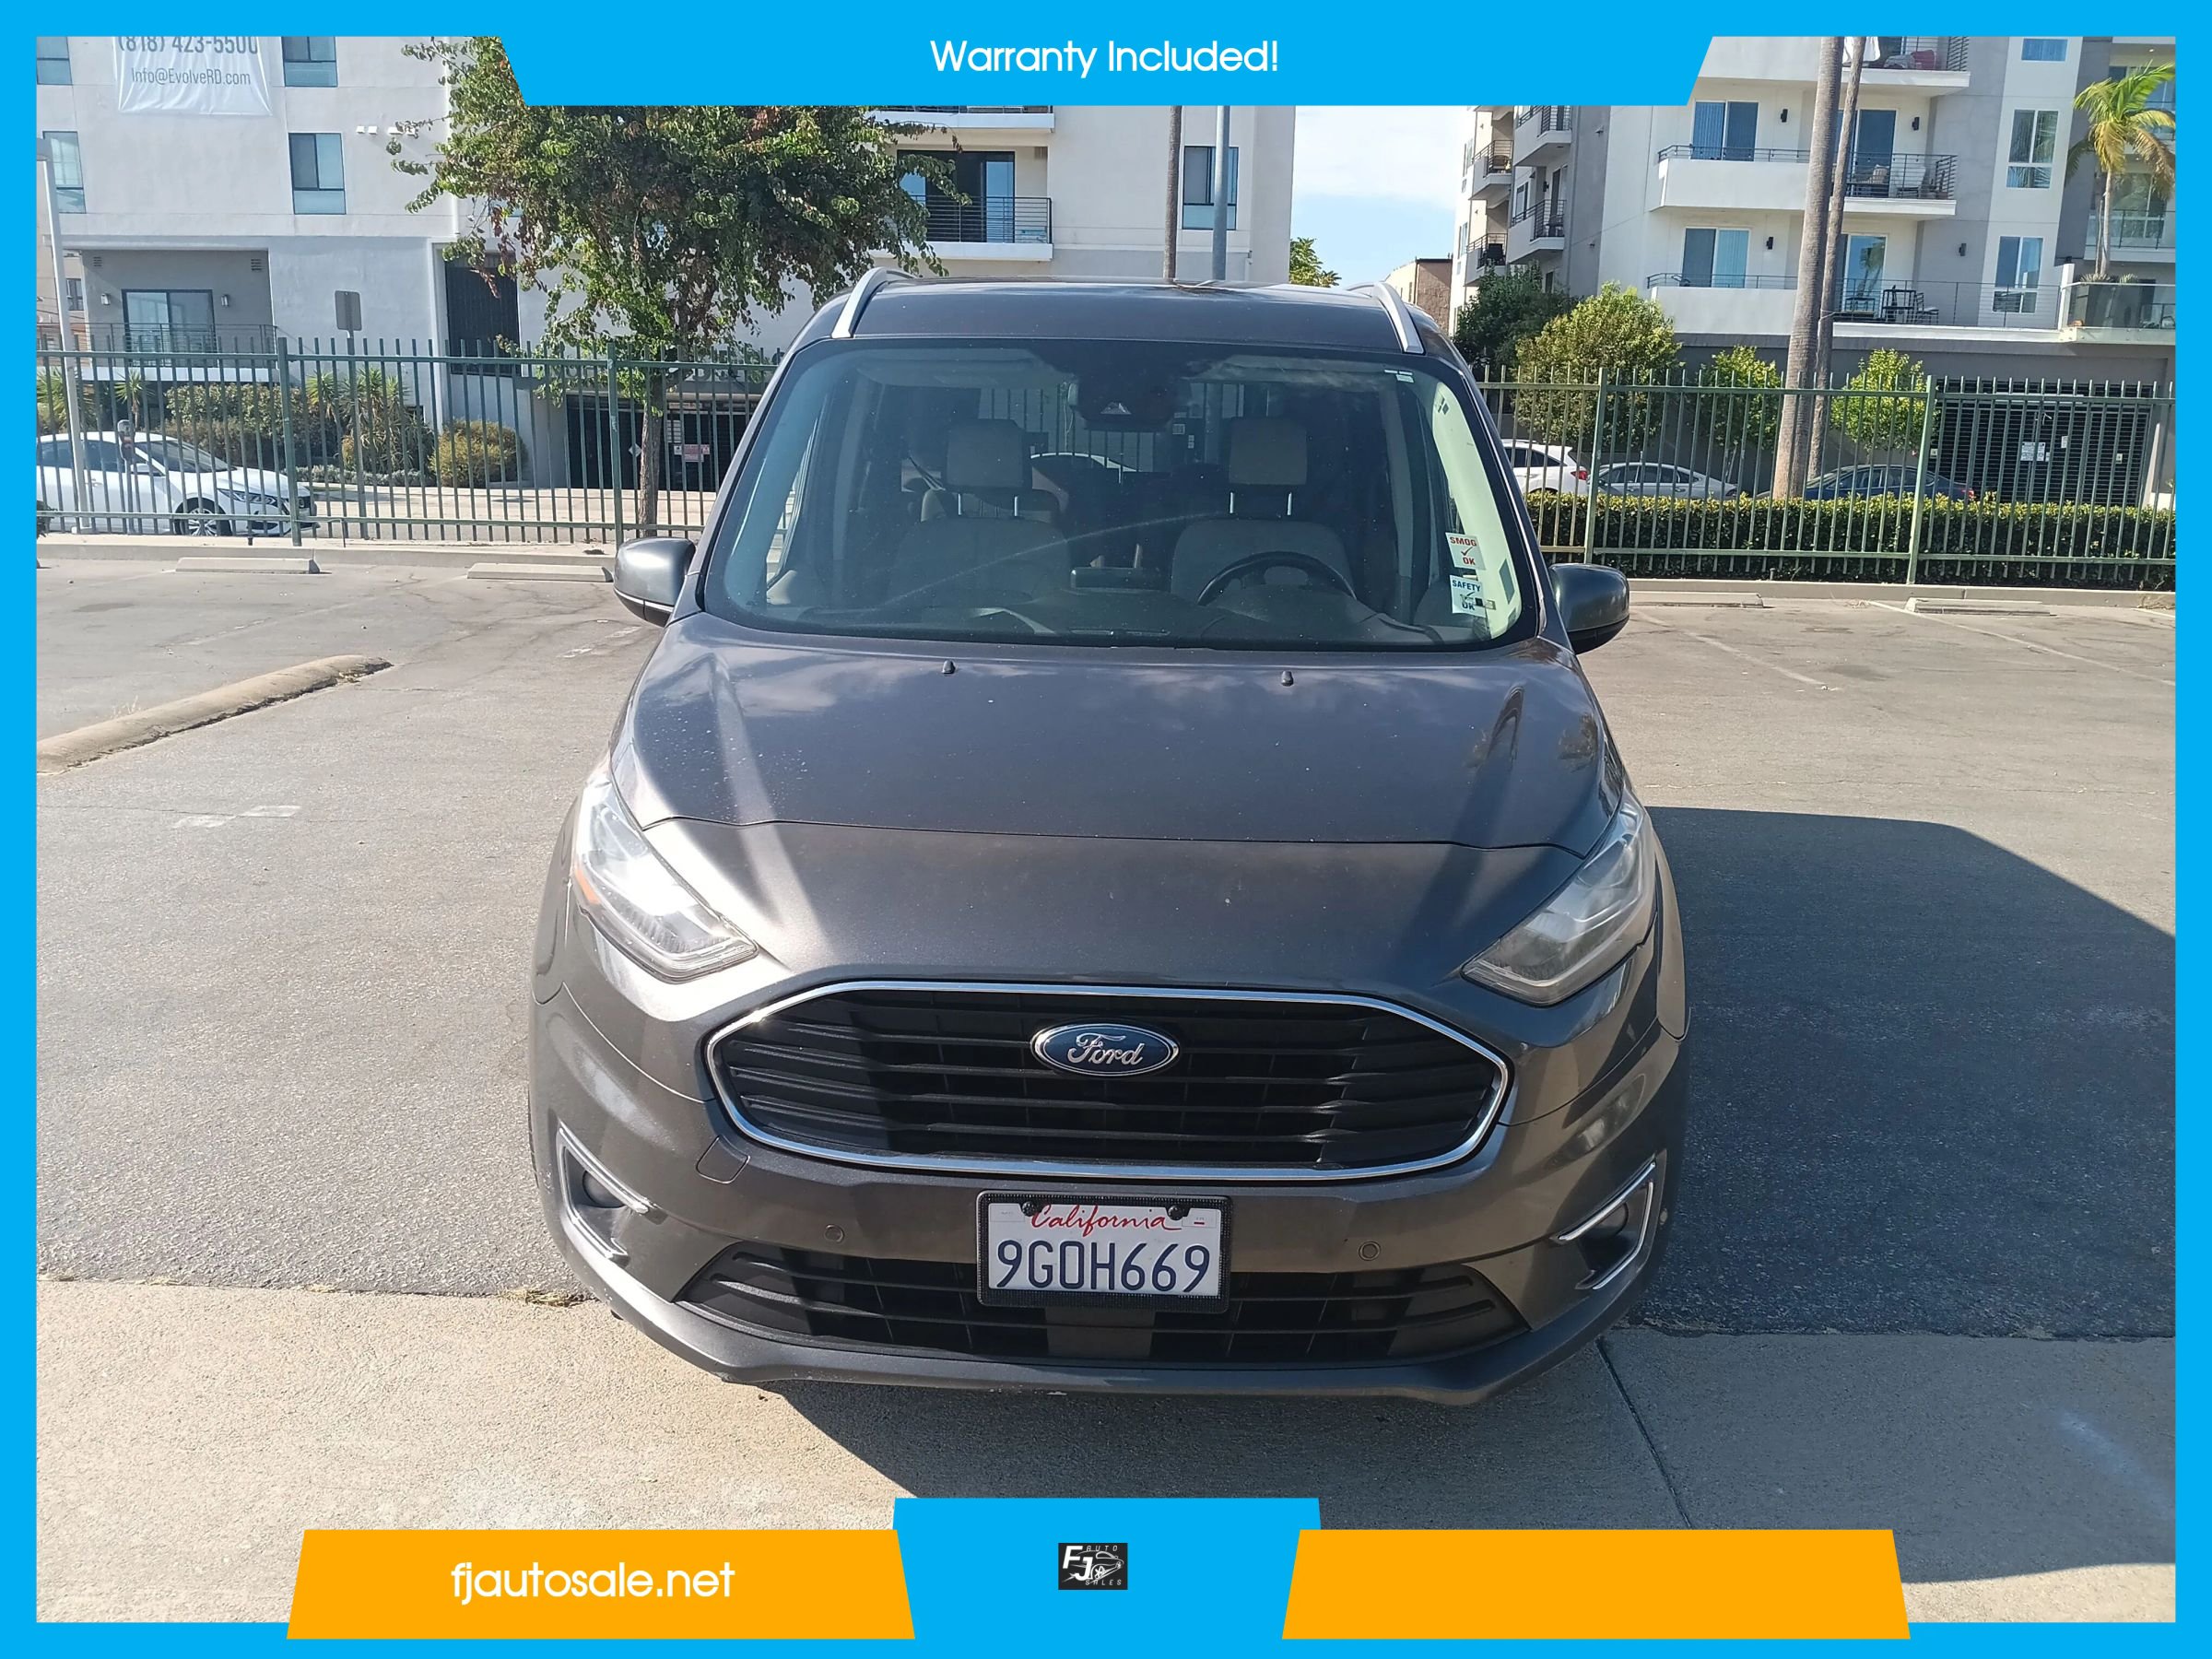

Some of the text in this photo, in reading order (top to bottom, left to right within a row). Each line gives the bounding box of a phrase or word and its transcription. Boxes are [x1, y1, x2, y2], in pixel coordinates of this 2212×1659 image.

[131, 67, 251, 86] Info@EvolveRD.com
[1449, 536, 1477, 547] SMOG
[1463, 557, 1476, 565] OK
[1453, 580, 1481, 592] SAFETY
[1462, 602, 1475, 610] OK
[1066, 1032, 1145, 1065] Ford
[1031, 1204, 1182, 1237] California
